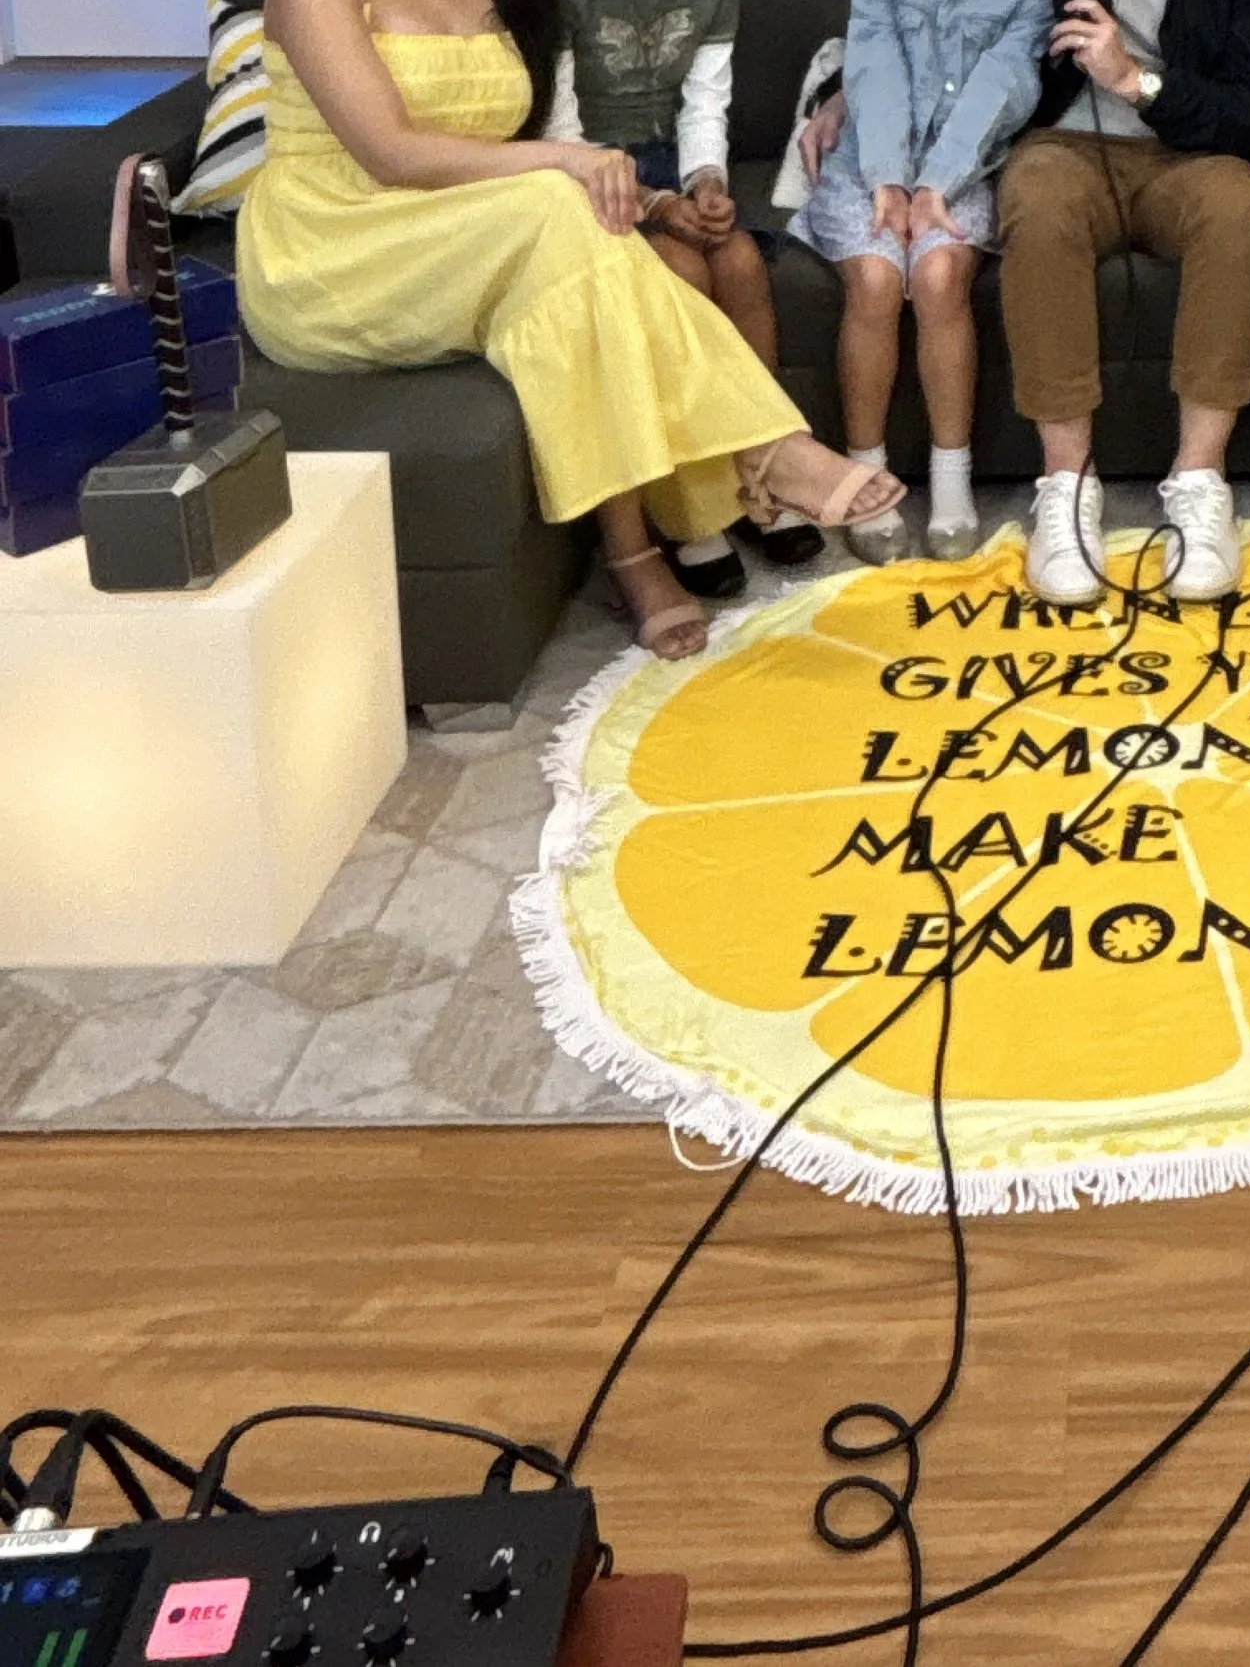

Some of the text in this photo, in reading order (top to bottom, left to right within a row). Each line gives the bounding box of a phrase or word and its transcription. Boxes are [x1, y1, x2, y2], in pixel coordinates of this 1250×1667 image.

[880, 650, 1171, 700] GIVES
[810, 803, 1184, 877] MAKE
[189, 1604, 228, 1622] REC
